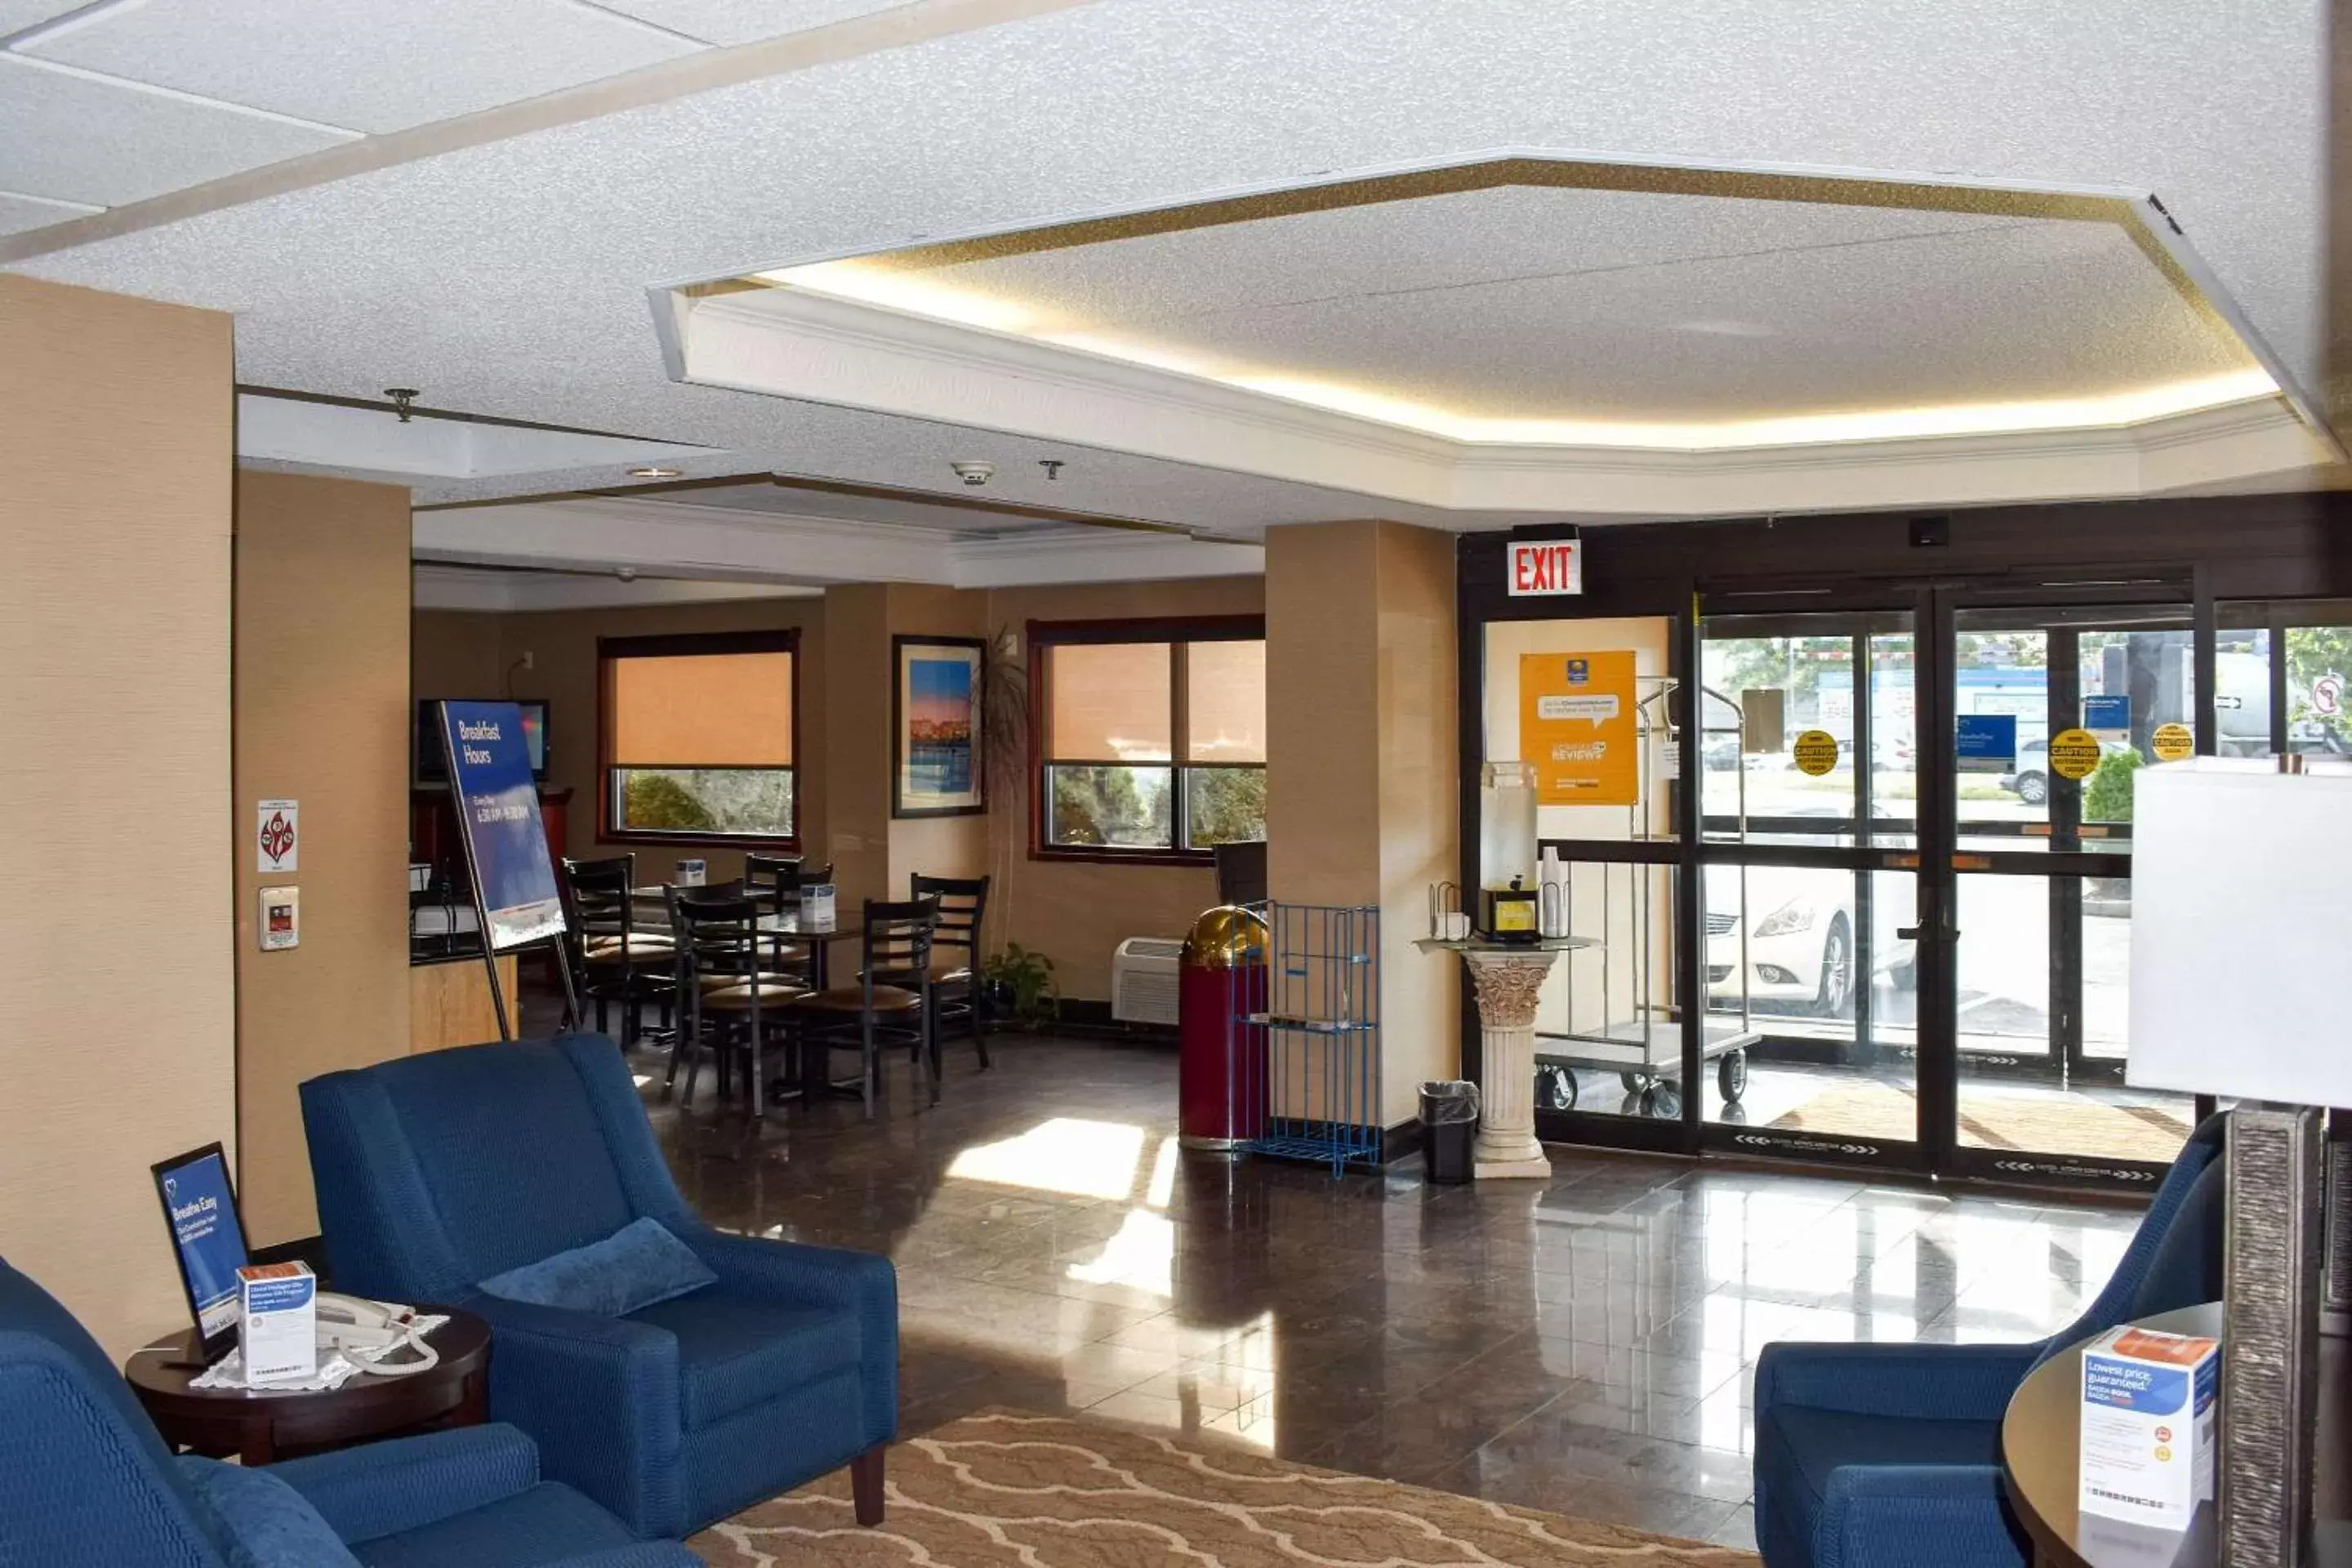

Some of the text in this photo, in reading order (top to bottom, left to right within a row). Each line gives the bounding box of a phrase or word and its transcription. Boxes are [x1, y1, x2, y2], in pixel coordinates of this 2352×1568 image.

[1516, 547, 1571, 590] EXIT
[459, 720, 501, 741] Breakfast
[1795, 746, 1837, 756] CAUTION
[2051, 746, 2098, 756] CAUTION
[2154, 738, 2190, 746] CAUTION
[463, 744, 492, 764] Hours
[198, 1196, 217, 1210] Easy
[2087, 1361, 2153, 1382] Lowest price,
[2088, 1372, 2147, 1391] guaranteed.
